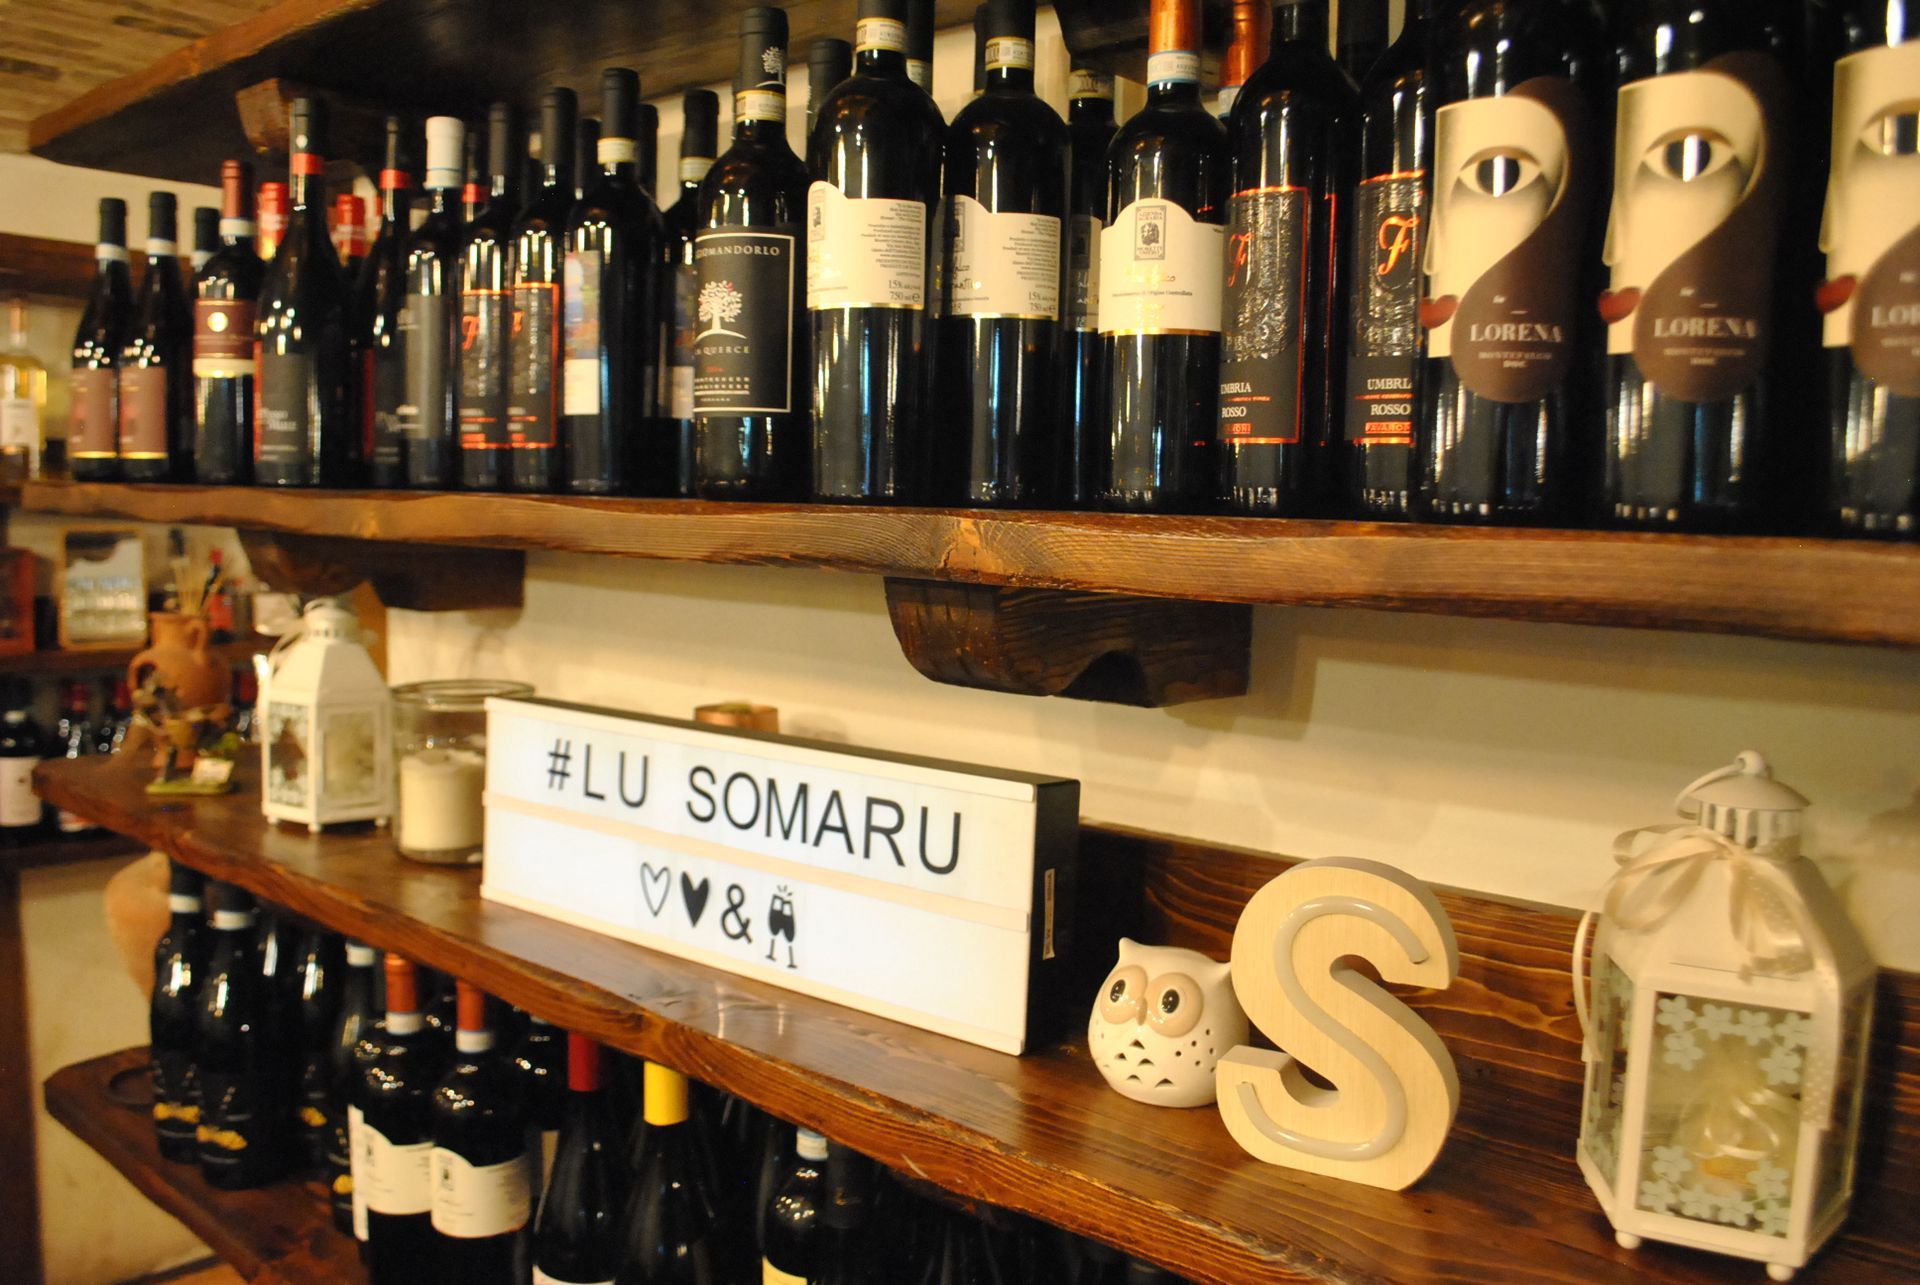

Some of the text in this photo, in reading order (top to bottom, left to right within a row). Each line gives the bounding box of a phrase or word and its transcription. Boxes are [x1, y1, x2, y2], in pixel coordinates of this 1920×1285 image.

[1470, 323, 1563, 342] LORENA
[1653, 317, 1757, 338] LORENA
[1370, 403, 1412, 415] ROSSO
[547, 737, 962, 876] #LU SOMARU
